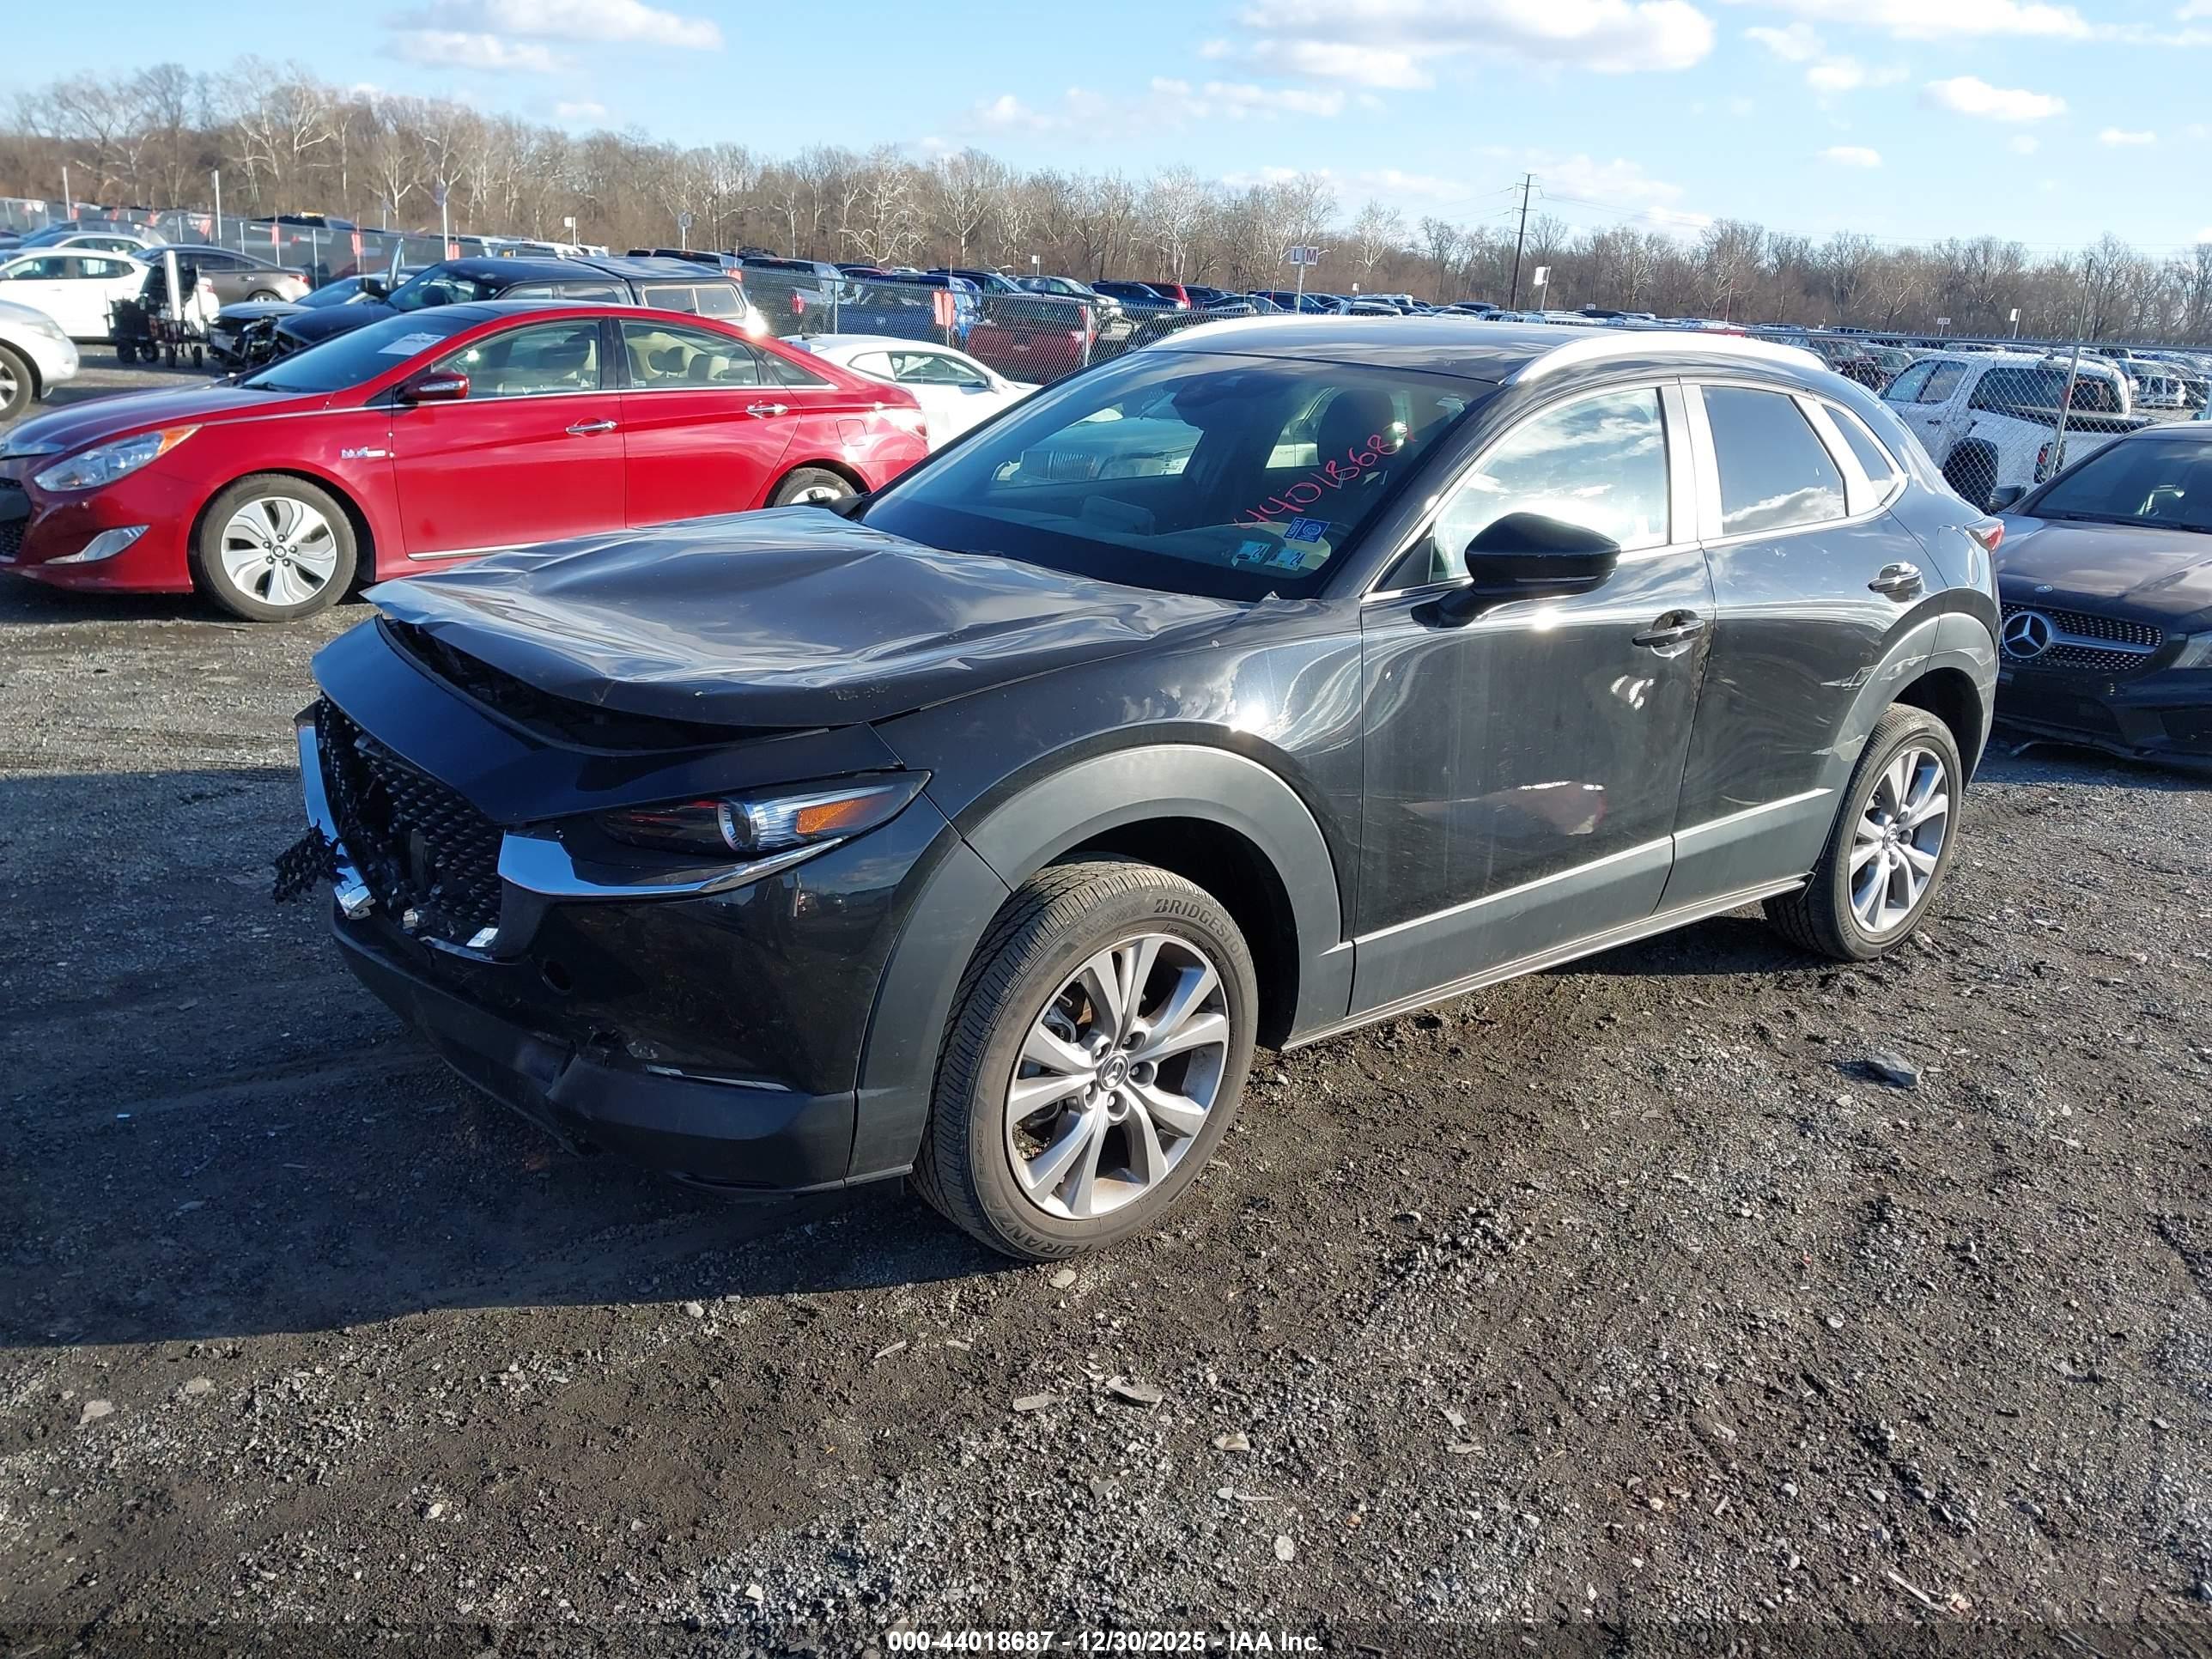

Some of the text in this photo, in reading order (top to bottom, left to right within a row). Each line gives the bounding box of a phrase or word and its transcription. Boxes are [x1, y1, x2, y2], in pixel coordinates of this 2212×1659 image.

[1293, 249, 1299, 261] L
[1306, 249, 1317, 262] M
[1290, 552, 1305, 567] 24
